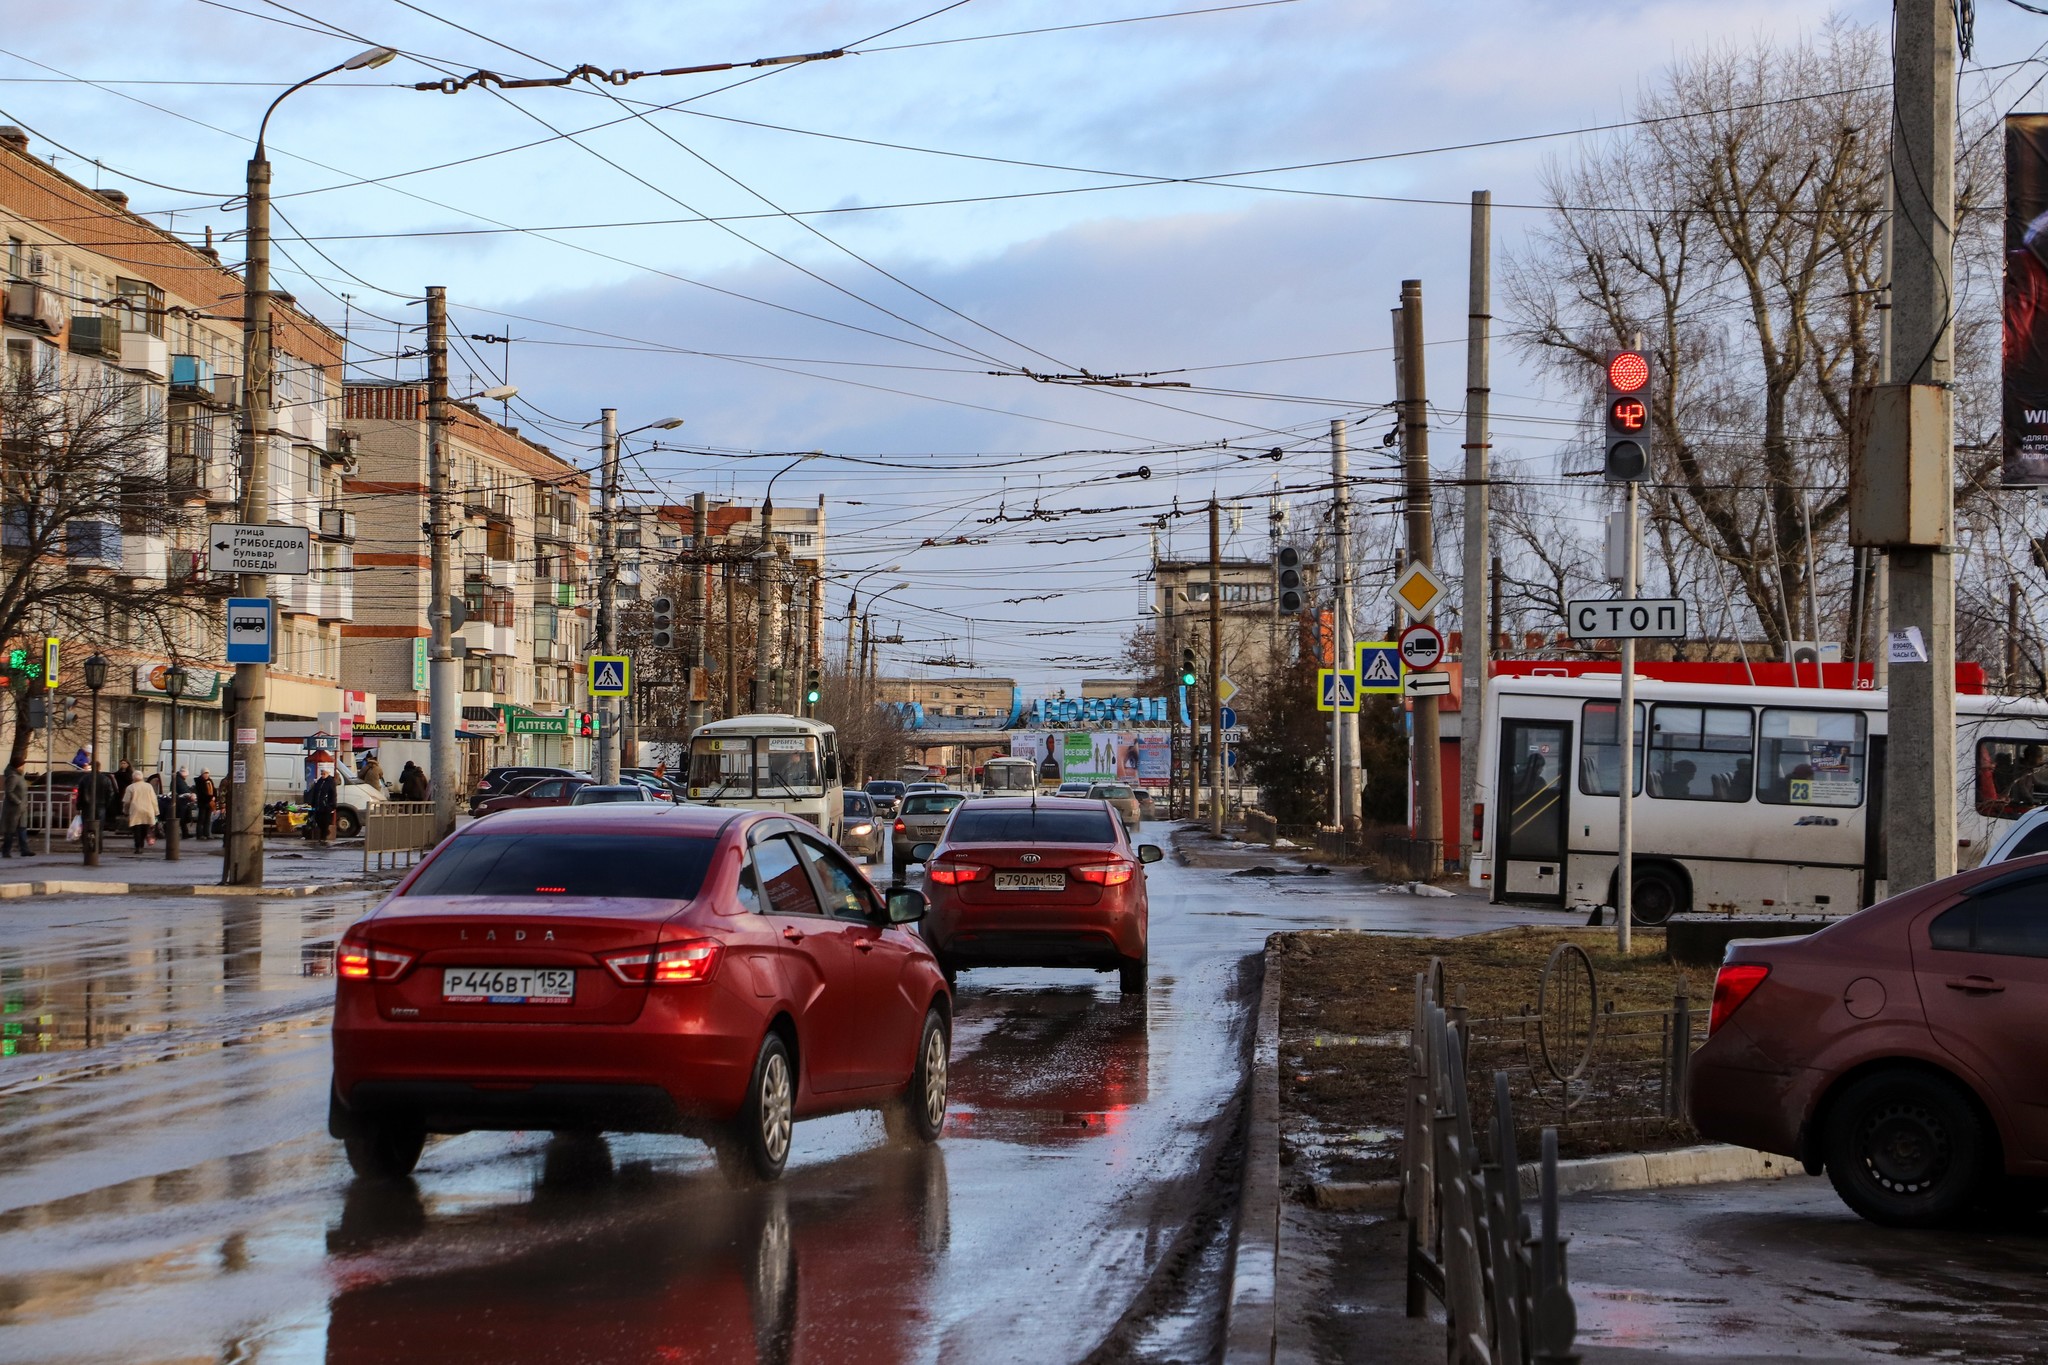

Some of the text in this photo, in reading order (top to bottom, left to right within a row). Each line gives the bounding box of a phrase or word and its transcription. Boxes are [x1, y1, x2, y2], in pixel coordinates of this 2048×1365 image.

[1616, 405, 1643, 427] 42
[2024, 410, 2048, 424] WI
[235, 528, 265, 537] улица
[234, 538, 304, 549] ГРИБОЕДОВА
[233, 548, 274, 559] бульвар
[232, 559, 277, 570] ПОБЕДЫ
[1579, 606, 1676, 632] СТОП
[352, 723, 411, 731] АРИКМАХЕРСКАЯ
[517, 720, 563, 731] АПТЕКА
[714, 741, 720, 750] 8
[692, 788, 698, 797] 8
[1791, 783, 1809, 800] 23
[1023, 855, 1038, 863] KIA
[460, 930, 555, 941] LADA
[537, 971, 568, 988] 152
